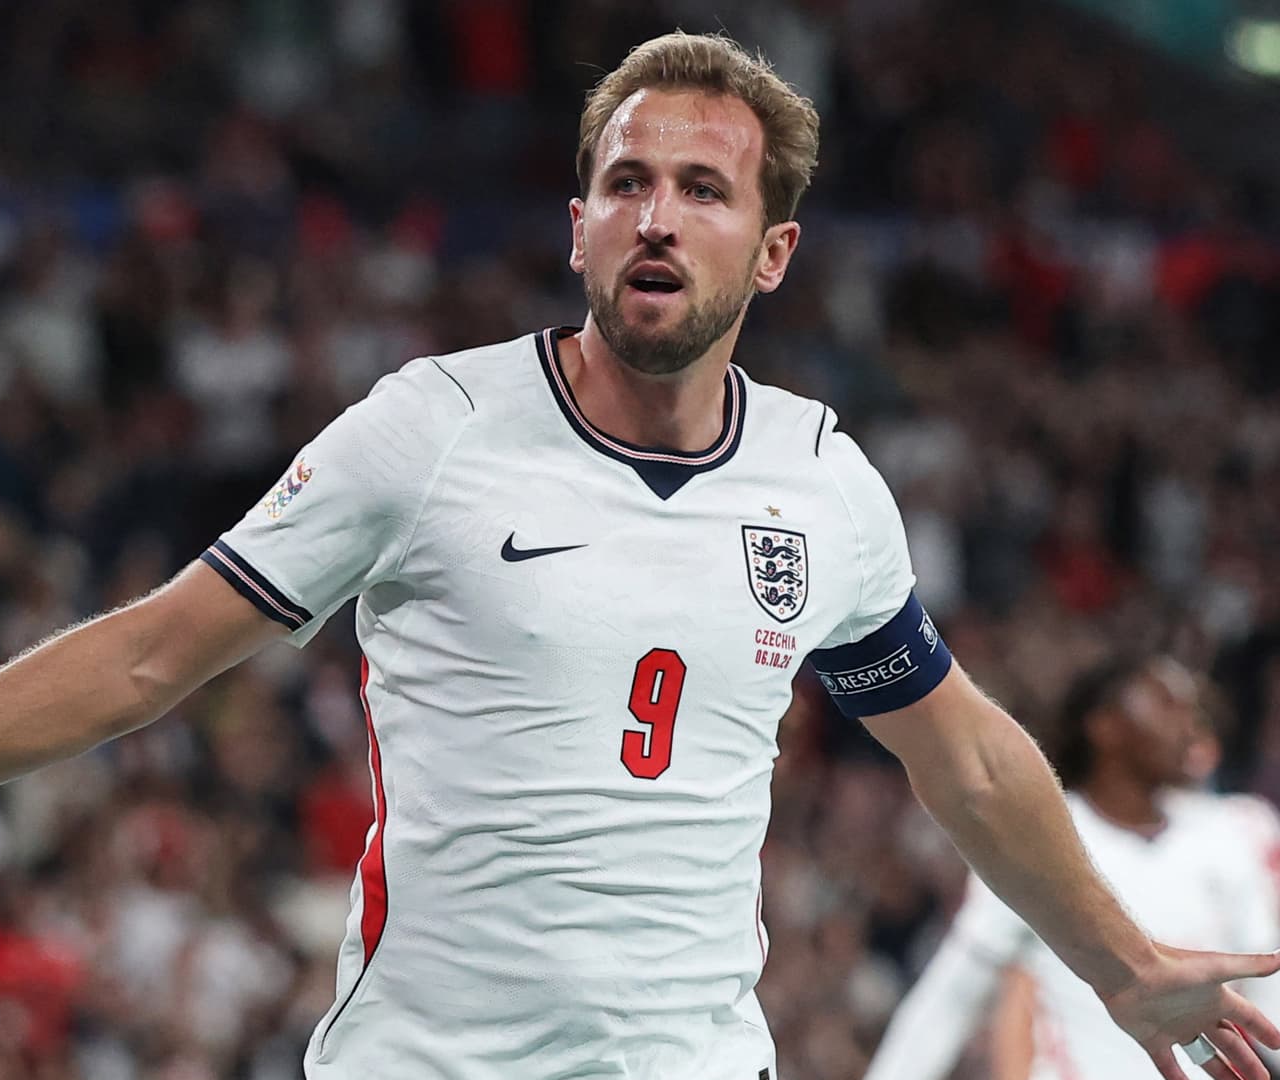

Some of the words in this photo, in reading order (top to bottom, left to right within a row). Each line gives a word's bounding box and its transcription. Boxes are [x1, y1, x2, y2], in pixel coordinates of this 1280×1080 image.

[754, 628, 796, 651] CZECHIA
[837, 649, 912, 691] RESPECT
[620, 647, 687, 780] 9
